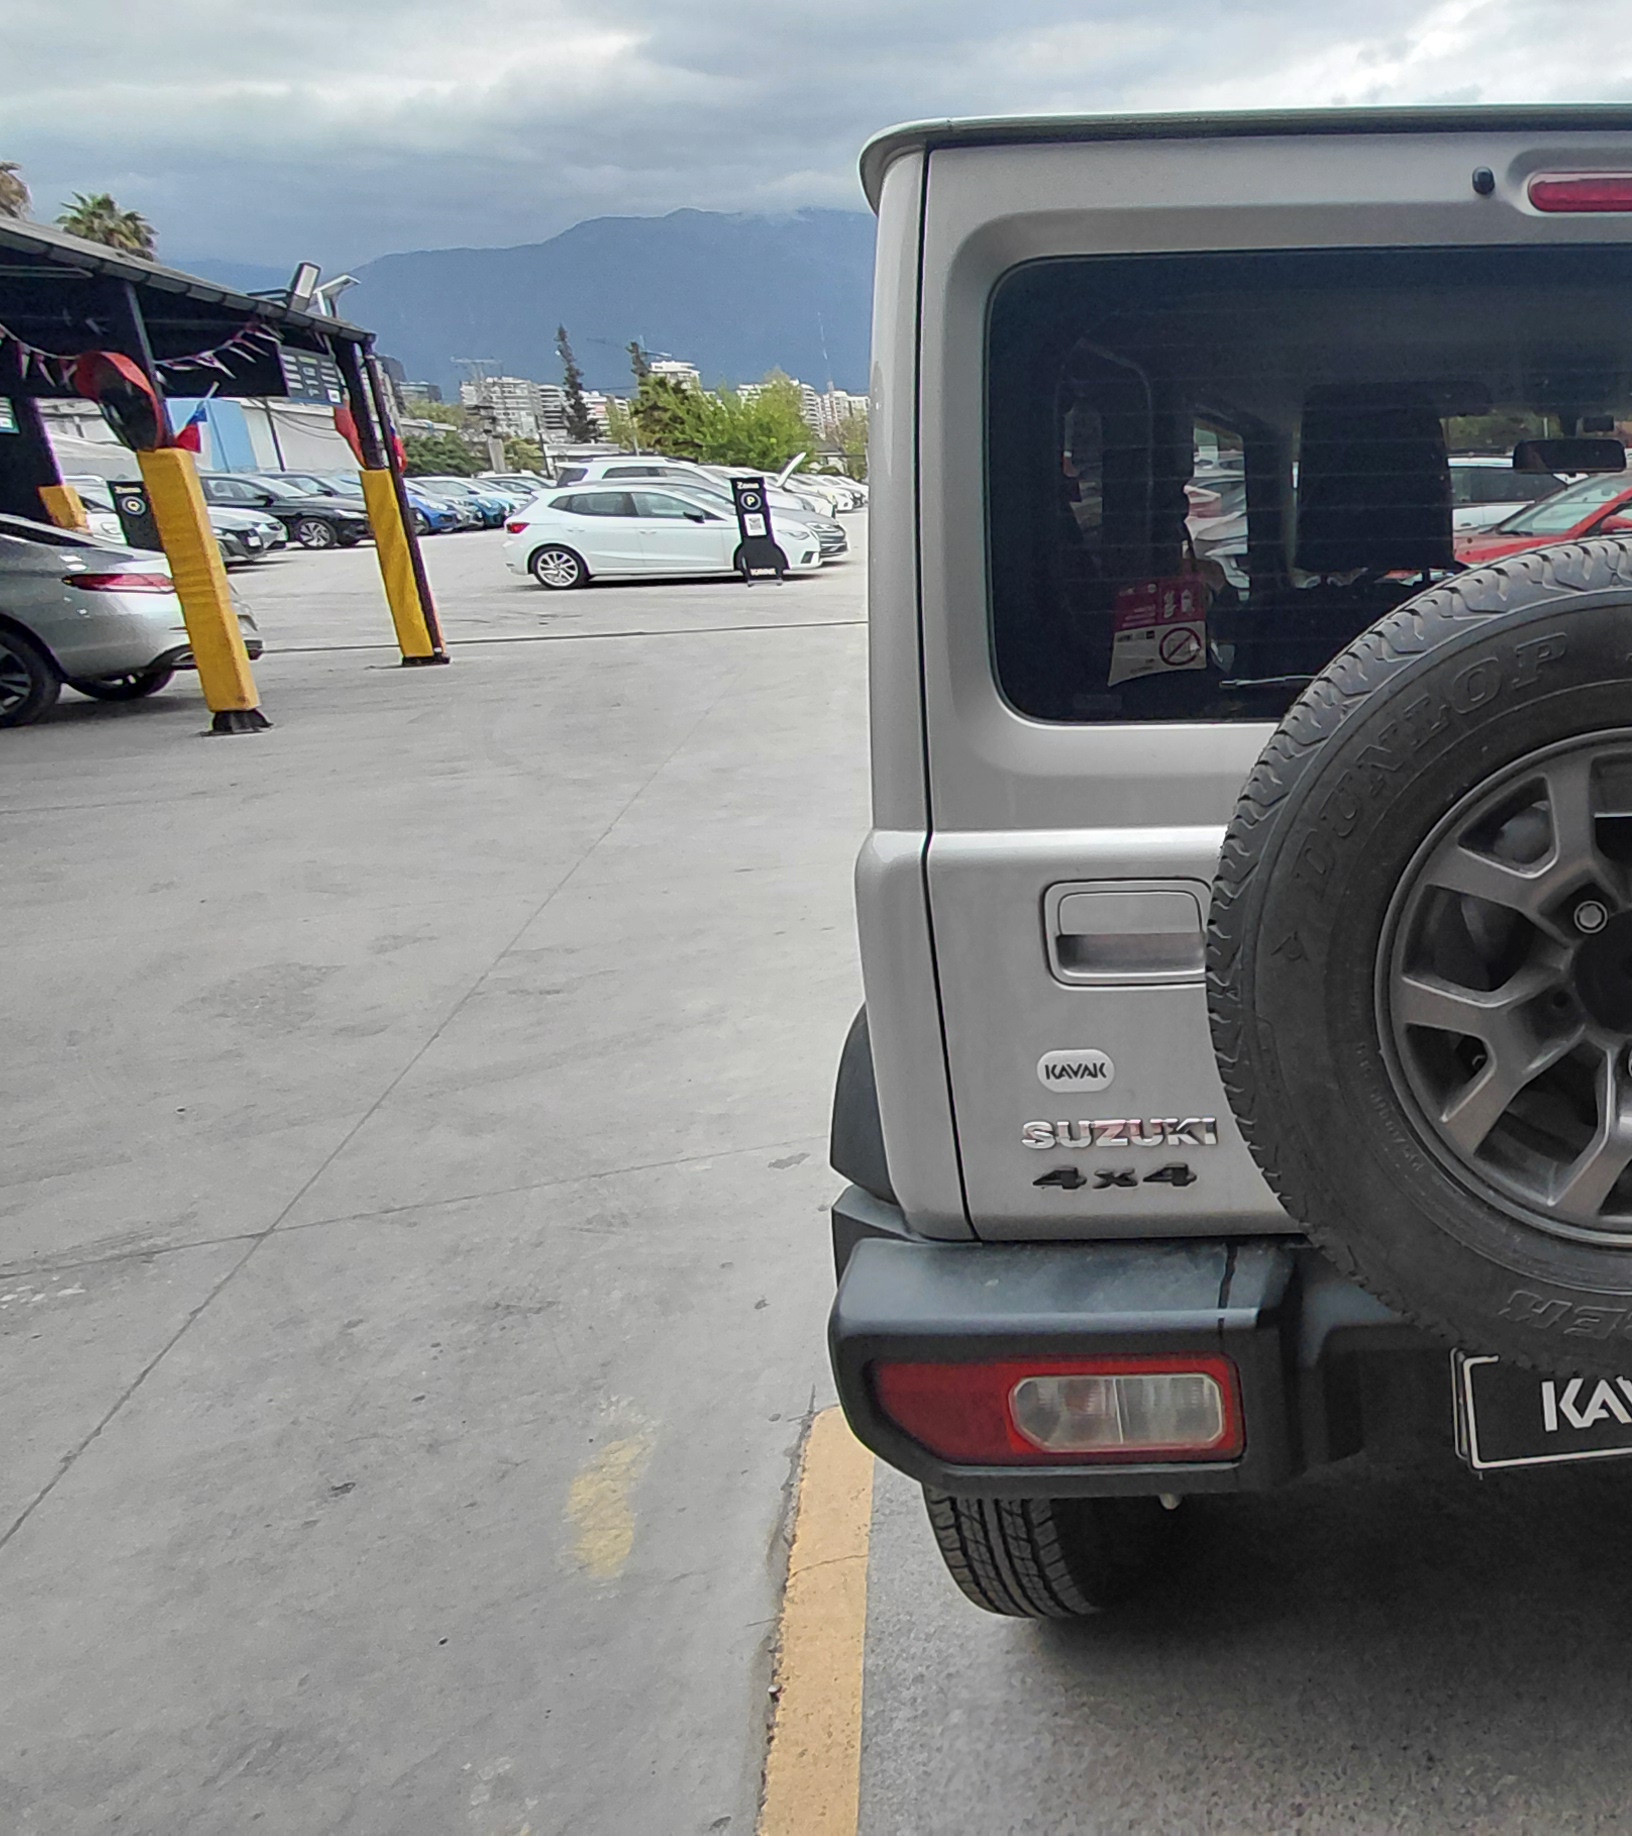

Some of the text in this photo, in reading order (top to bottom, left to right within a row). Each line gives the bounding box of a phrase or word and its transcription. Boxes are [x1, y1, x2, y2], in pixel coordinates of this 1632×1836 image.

[746, 496, 755, 505] P
[1294, 631, 1568, 899] DUNLOP
[1045, 1062, 1107, 1080] KAVAK
[1022, 1117, 1217, 1149] SUZUKI
[1032, 1162, 1198, 1190] 4x4
